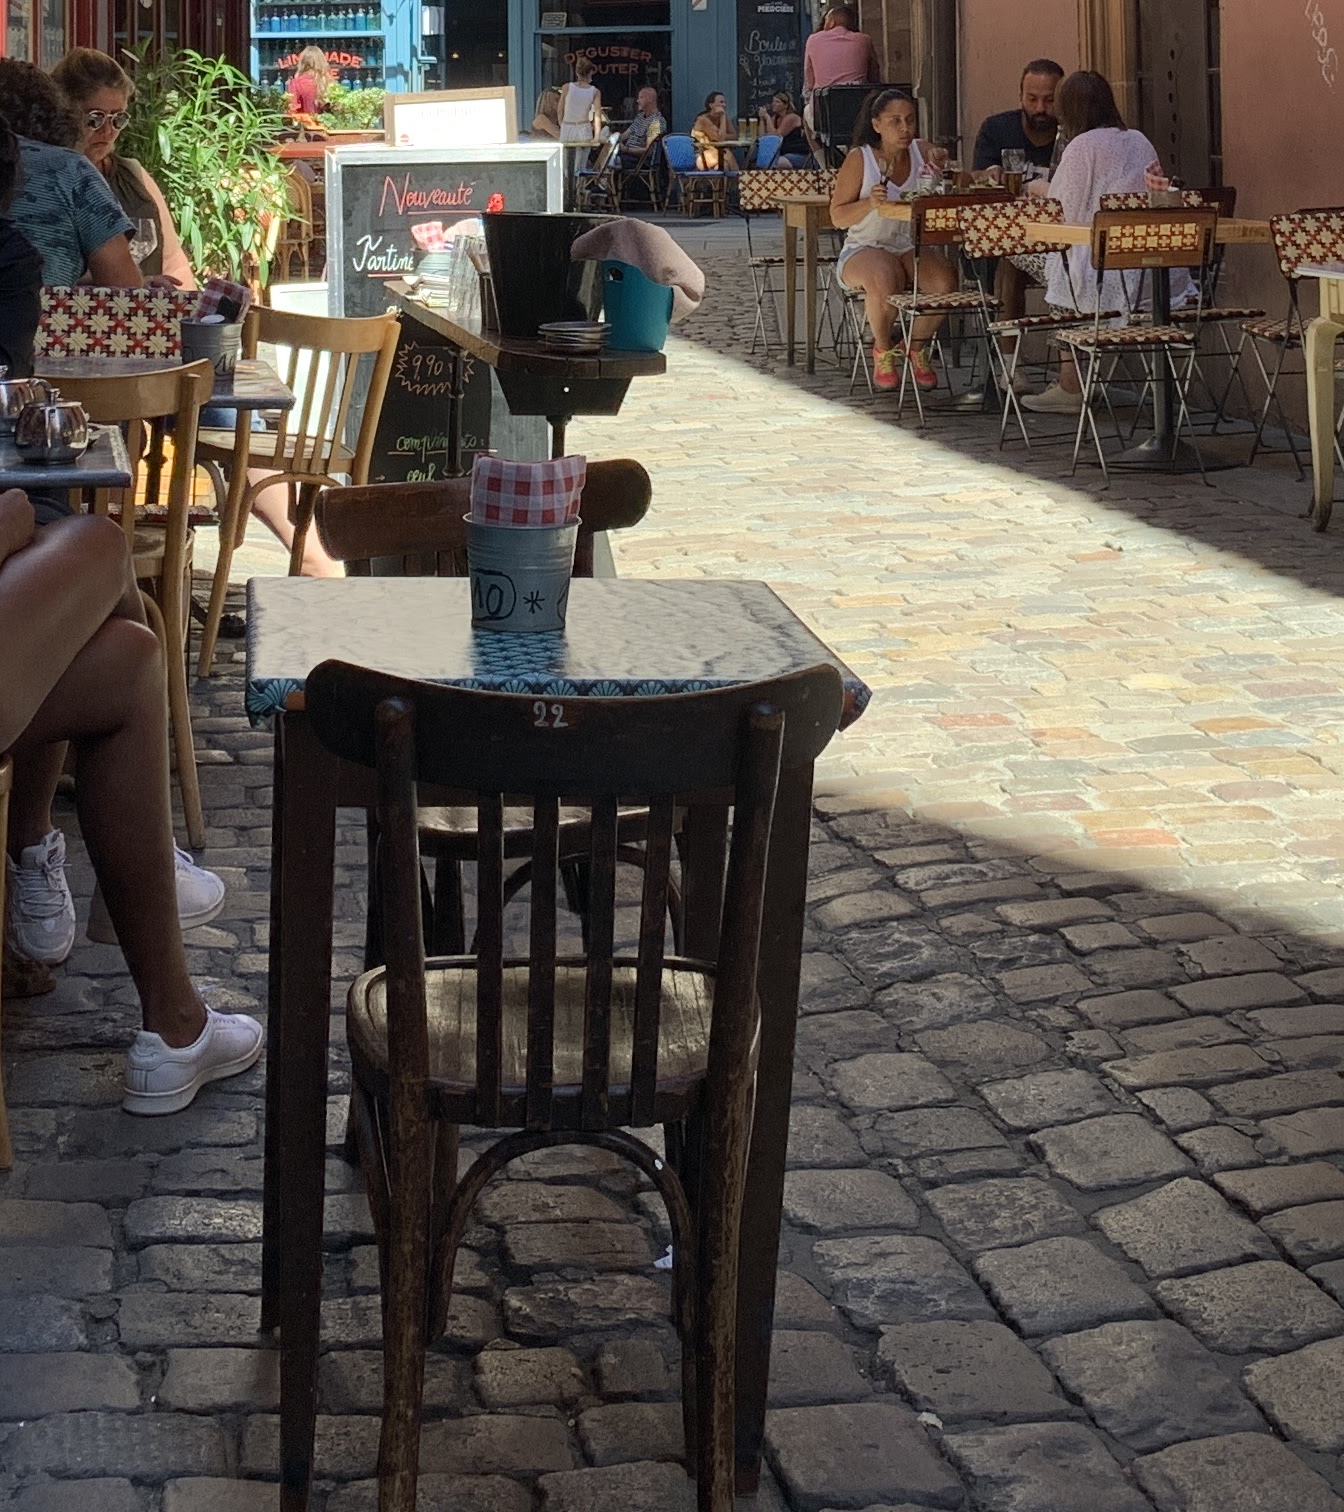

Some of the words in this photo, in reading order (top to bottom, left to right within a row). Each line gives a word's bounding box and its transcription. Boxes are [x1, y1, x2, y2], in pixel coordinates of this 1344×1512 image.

[590, 63, 639, 75] OUTER
[379, 172, 477, 217] Nouveauté
[533, 701, 569, 729] 22
